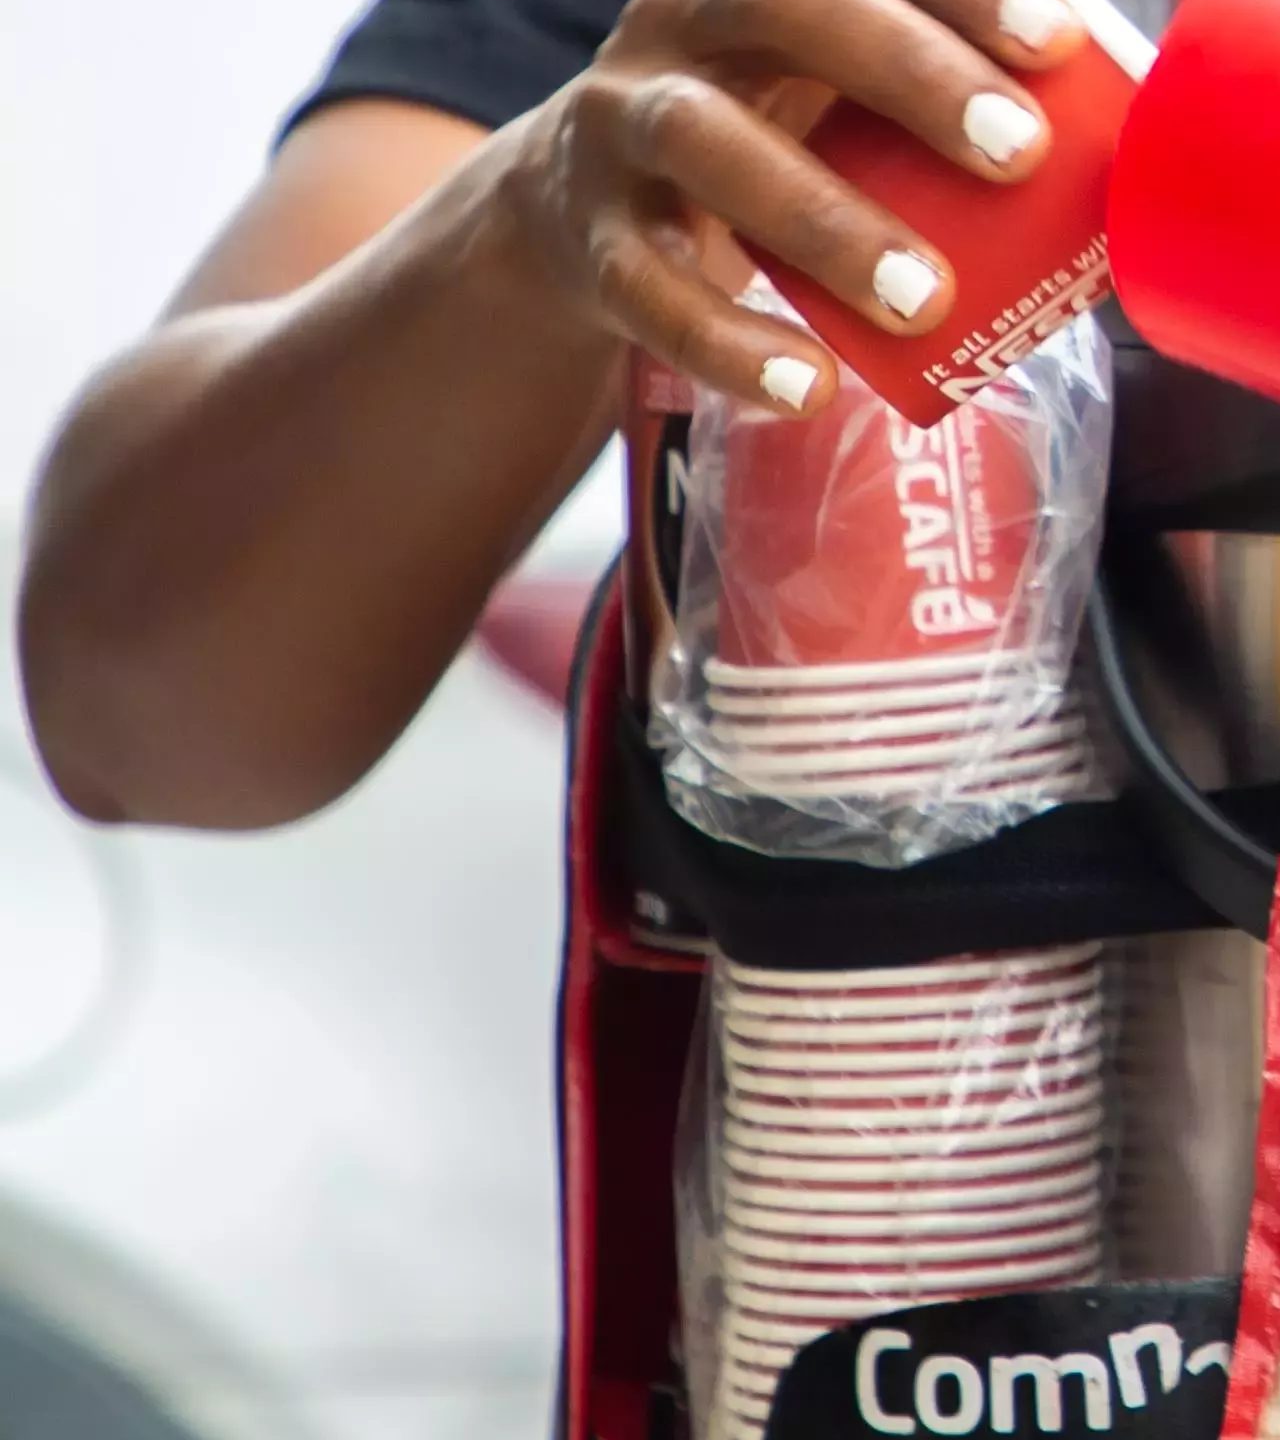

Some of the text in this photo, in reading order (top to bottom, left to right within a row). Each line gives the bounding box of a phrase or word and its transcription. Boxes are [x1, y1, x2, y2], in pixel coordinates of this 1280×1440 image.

[922, 363, 950, 386] It
[951, 330, 991, 365] all
[991, 268, 1072, 335] starts
[884, 404, 998, 637] SCAFÉ
